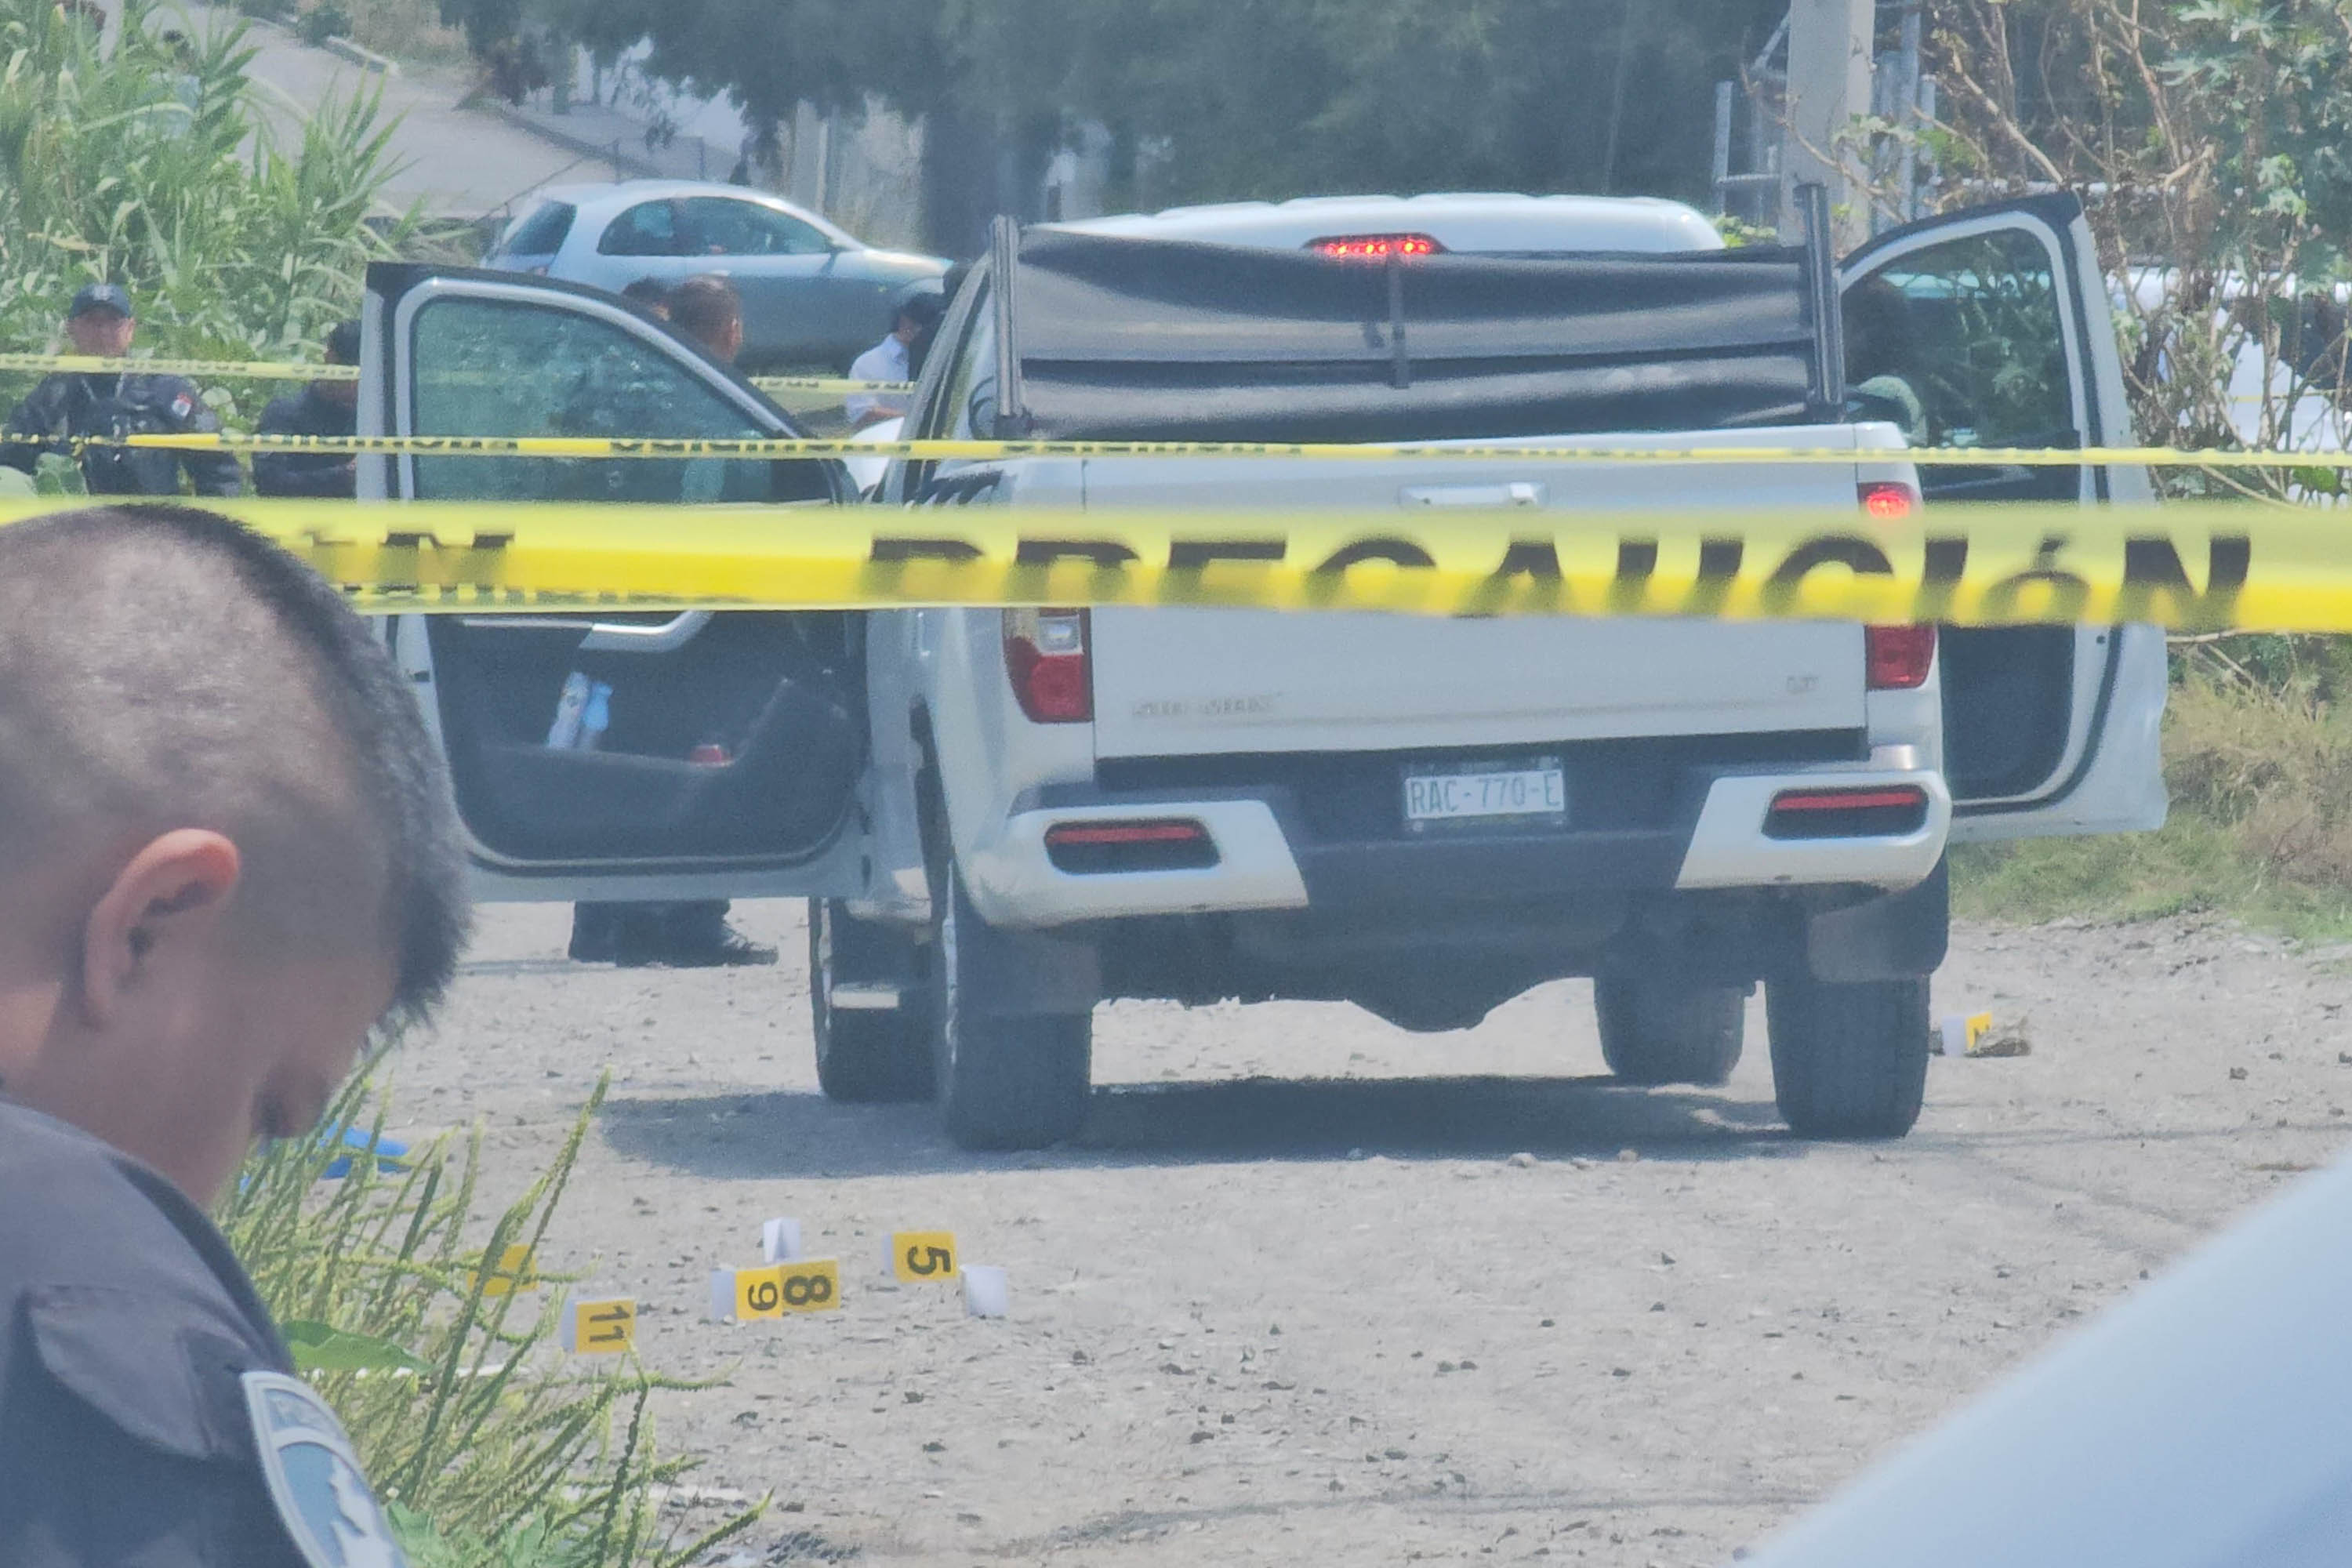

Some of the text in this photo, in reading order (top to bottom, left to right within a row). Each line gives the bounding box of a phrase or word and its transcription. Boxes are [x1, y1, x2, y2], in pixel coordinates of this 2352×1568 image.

[906, 1245, 952, 1276] 5
[747, 1280, 779, 1312] 9
[784, 1275, 832, 1306] 8
[589, 1304, 631, 1343] 11
